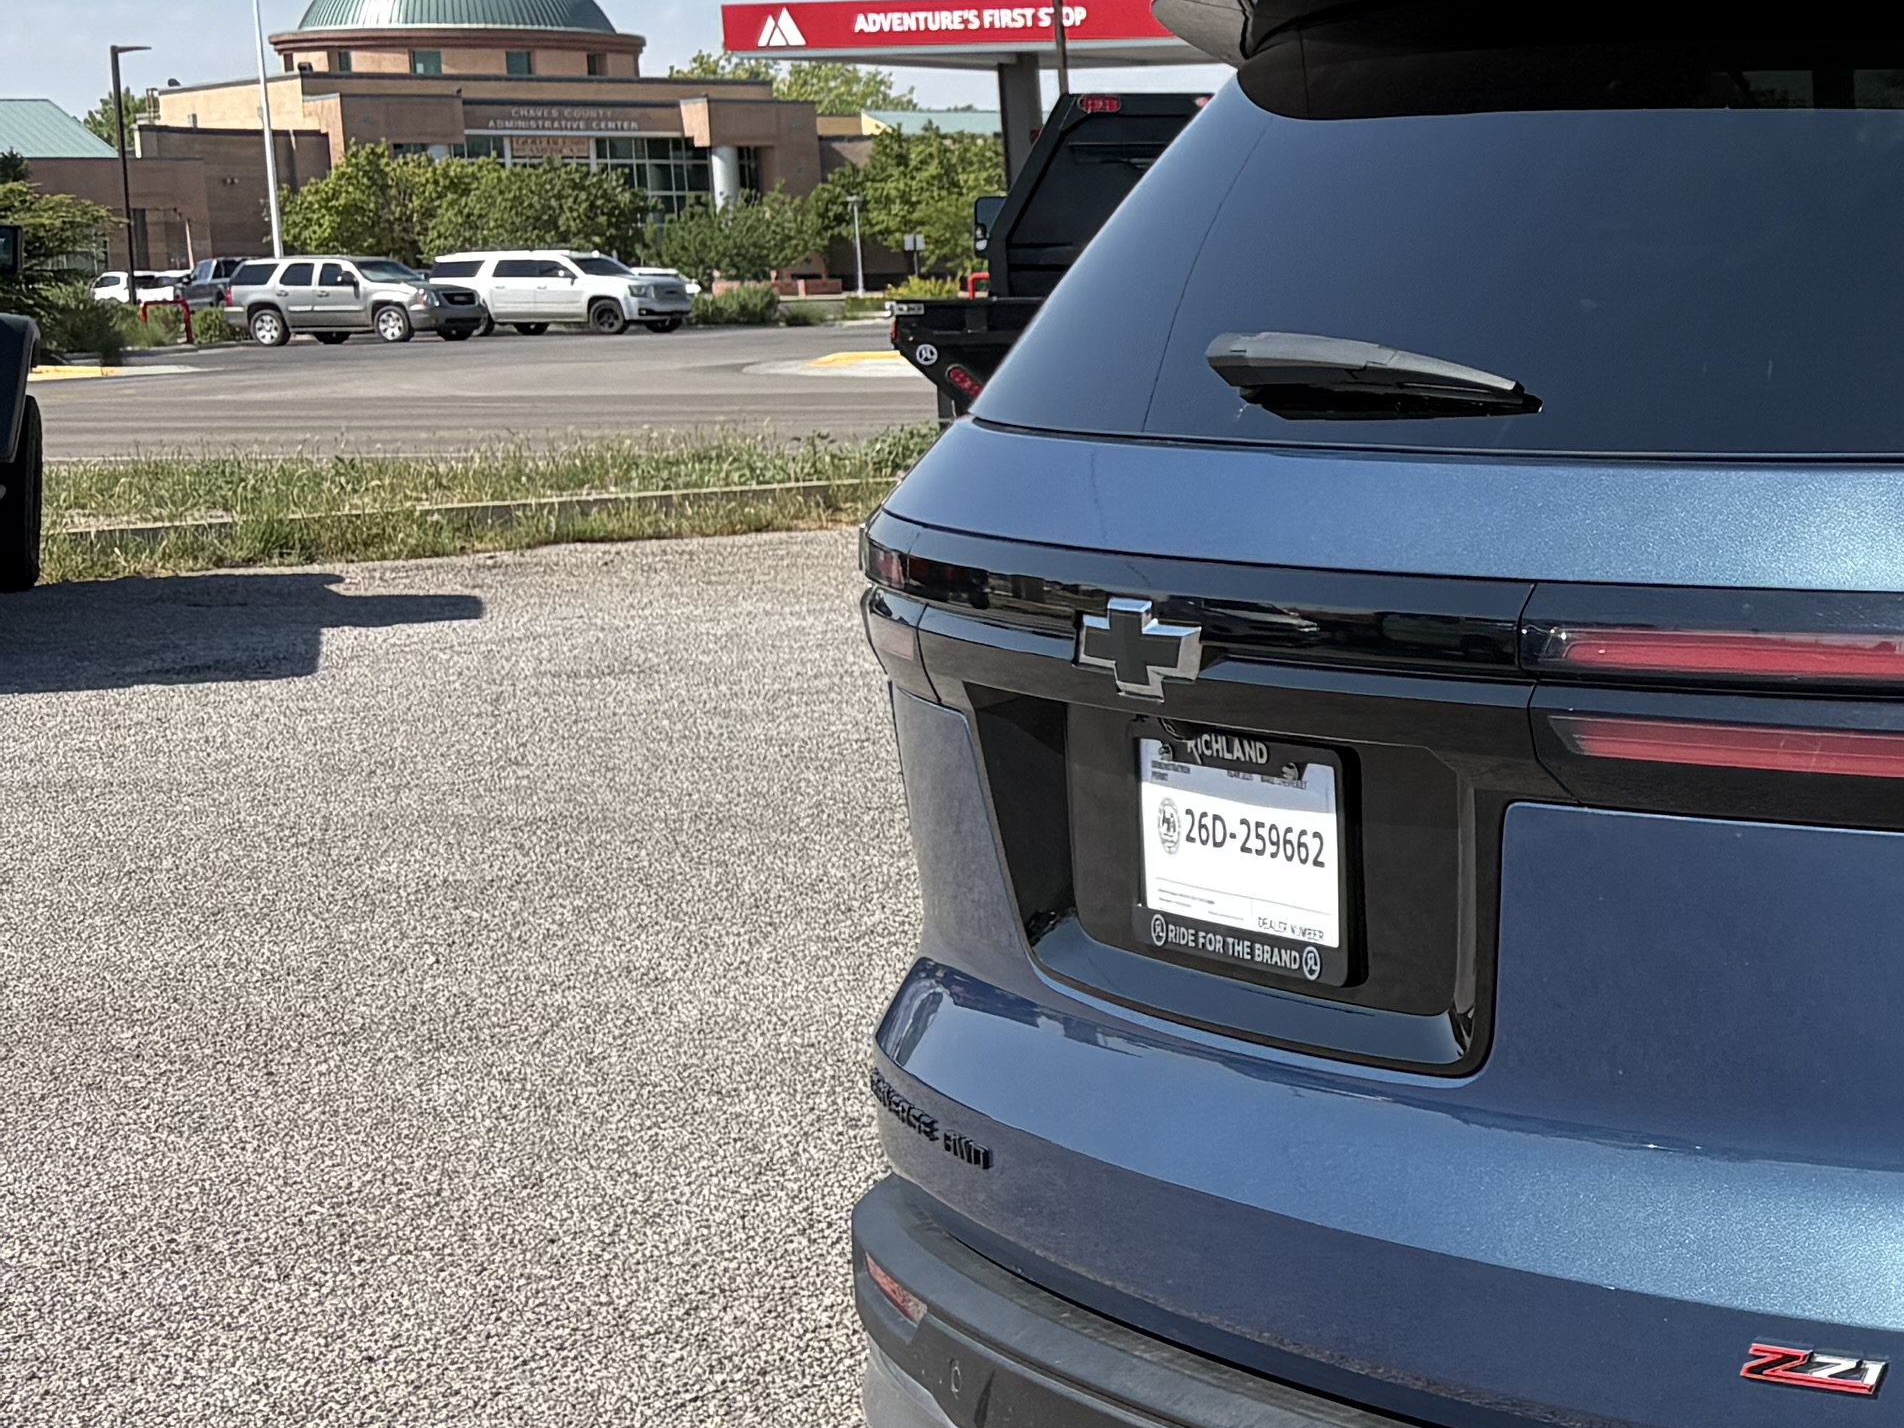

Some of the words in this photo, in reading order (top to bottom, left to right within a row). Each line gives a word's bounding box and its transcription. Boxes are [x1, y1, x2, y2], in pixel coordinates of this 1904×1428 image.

[854, 9, 980, 33] ADVENTURE'S
[982, 8, 1034, 29] FIRST
[1037, 6, 1087, 27] SOP
[488, 119, 585, 129] ADMINISTRATIVE
[592, 121, 639, 130] CENTER
[511, 108, 560, 118] CHAVES
[564, 108, 612, 118] COUNTY
[1184, 808, 1326, 868] 26D-259662
[1167, 924, 1196, 948] RIDE
[1198, 931, 1224, 954] FOR
[1226, 937, 1252, 960] THE
[1254, 944, 1301, 970] BRAND
[1739, 1342, 1888, 1397] Z71
